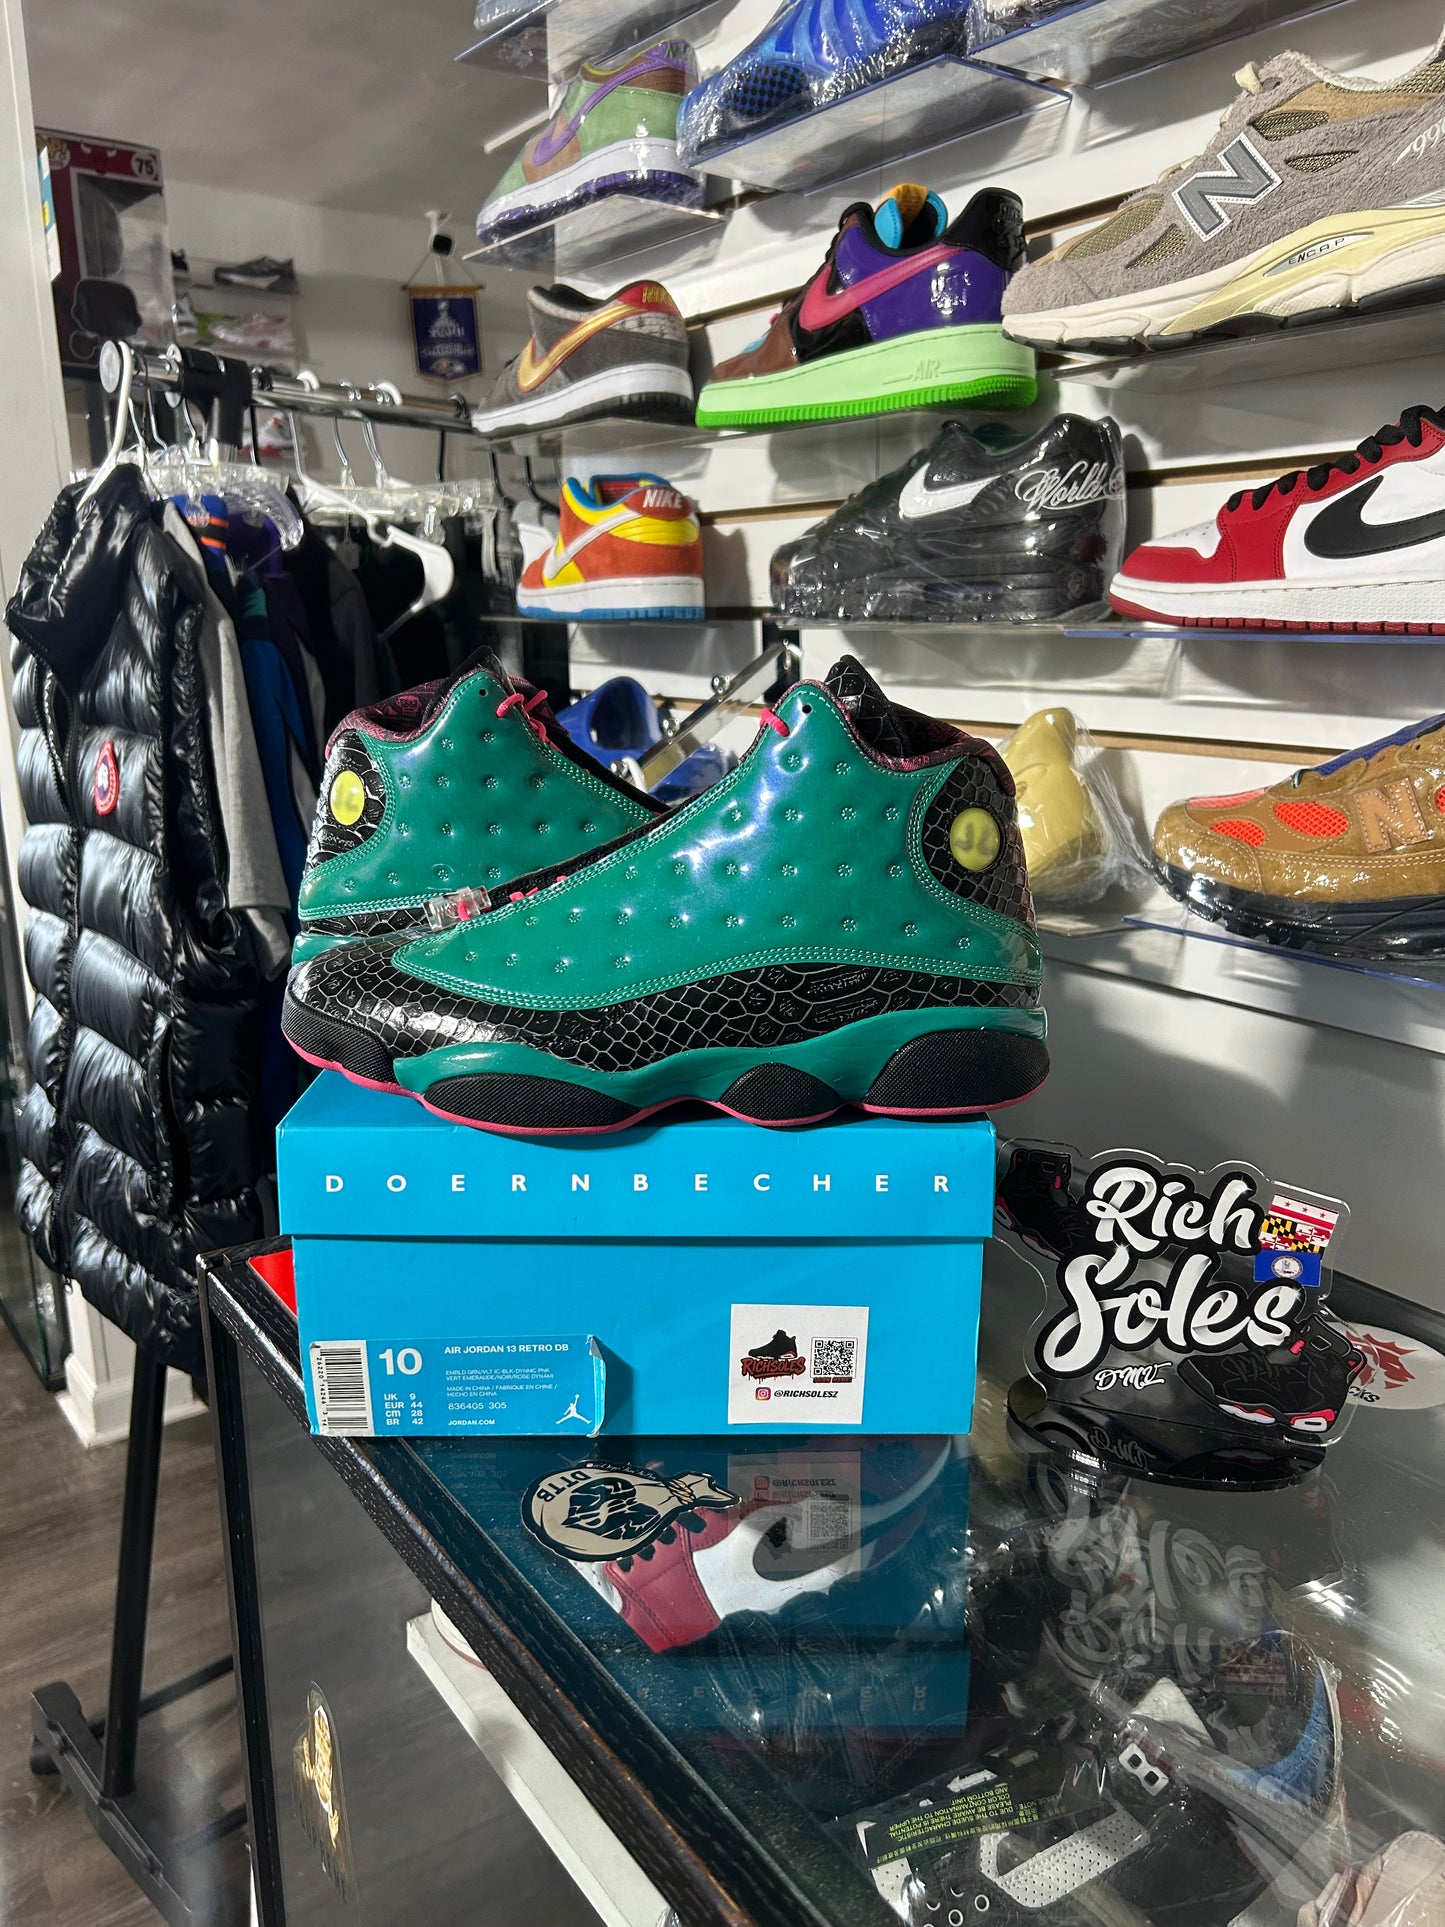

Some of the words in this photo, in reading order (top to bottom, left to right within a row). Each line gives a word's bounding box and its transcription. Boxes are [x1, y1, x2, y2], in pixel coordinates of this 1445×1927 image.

[135, 157, 154, 176] 75
[1288, 237, 1345, 265] ENCAP
[913, 359, 941, 381] AIR
[642, 489, 683, 509] NIKE
[325, 1174, 949, 1193] DOERNBECHER
[1086, 1167, 1257, 1253] Rich
[1042, 1247, 1302, 1373] Soles
[444, 1346, 462, 1354] AIR
[463, 1345, 504, 1354] JORDAN
[506, 1345, 517, 1353] 13
[520, 1344, 552, 1352] RETRO
[554, 1343, 569, 1351] DB
[378, 1347, 423, 1376] 10
[1094, 1361, 1173, 1391] DMV
[383, 1393, 398, 1401] UK
[409, 1392, 417, 1401] 9
[774, 1390, 839, 1399] @RICHSOLESZ
[384, 1401, 405, 1409] EUR
[410, 1401, 424, 1409] 44
[447, 1402, 484, 1410] 836405
[489, 1401, 507, 1409] 305
[385, 1409, 401, 1417] cm
[410, 1409, 424, 1417] 28
[386, 1418, 400, 1426] BR
[536, 1470, 592, 1503] DTTB
[966, 1789, 993, 1801] BOTTOM
[993, 1785, 1008, 1794] AND
[986, 1792, 1010, 1803] COLOR
[986, 1799, 1011, 1810] PLEASE
[998, 1805, 1013, 1814] DUE
[952, 1807, 976, 1818] AWARE
[974, 1811, 987, 1820] THE
[910, 1815, 923, 1823] THE
[929, 1813, 951, 1824] THERE
[951, 1814, 974, 1826] SUEDE
